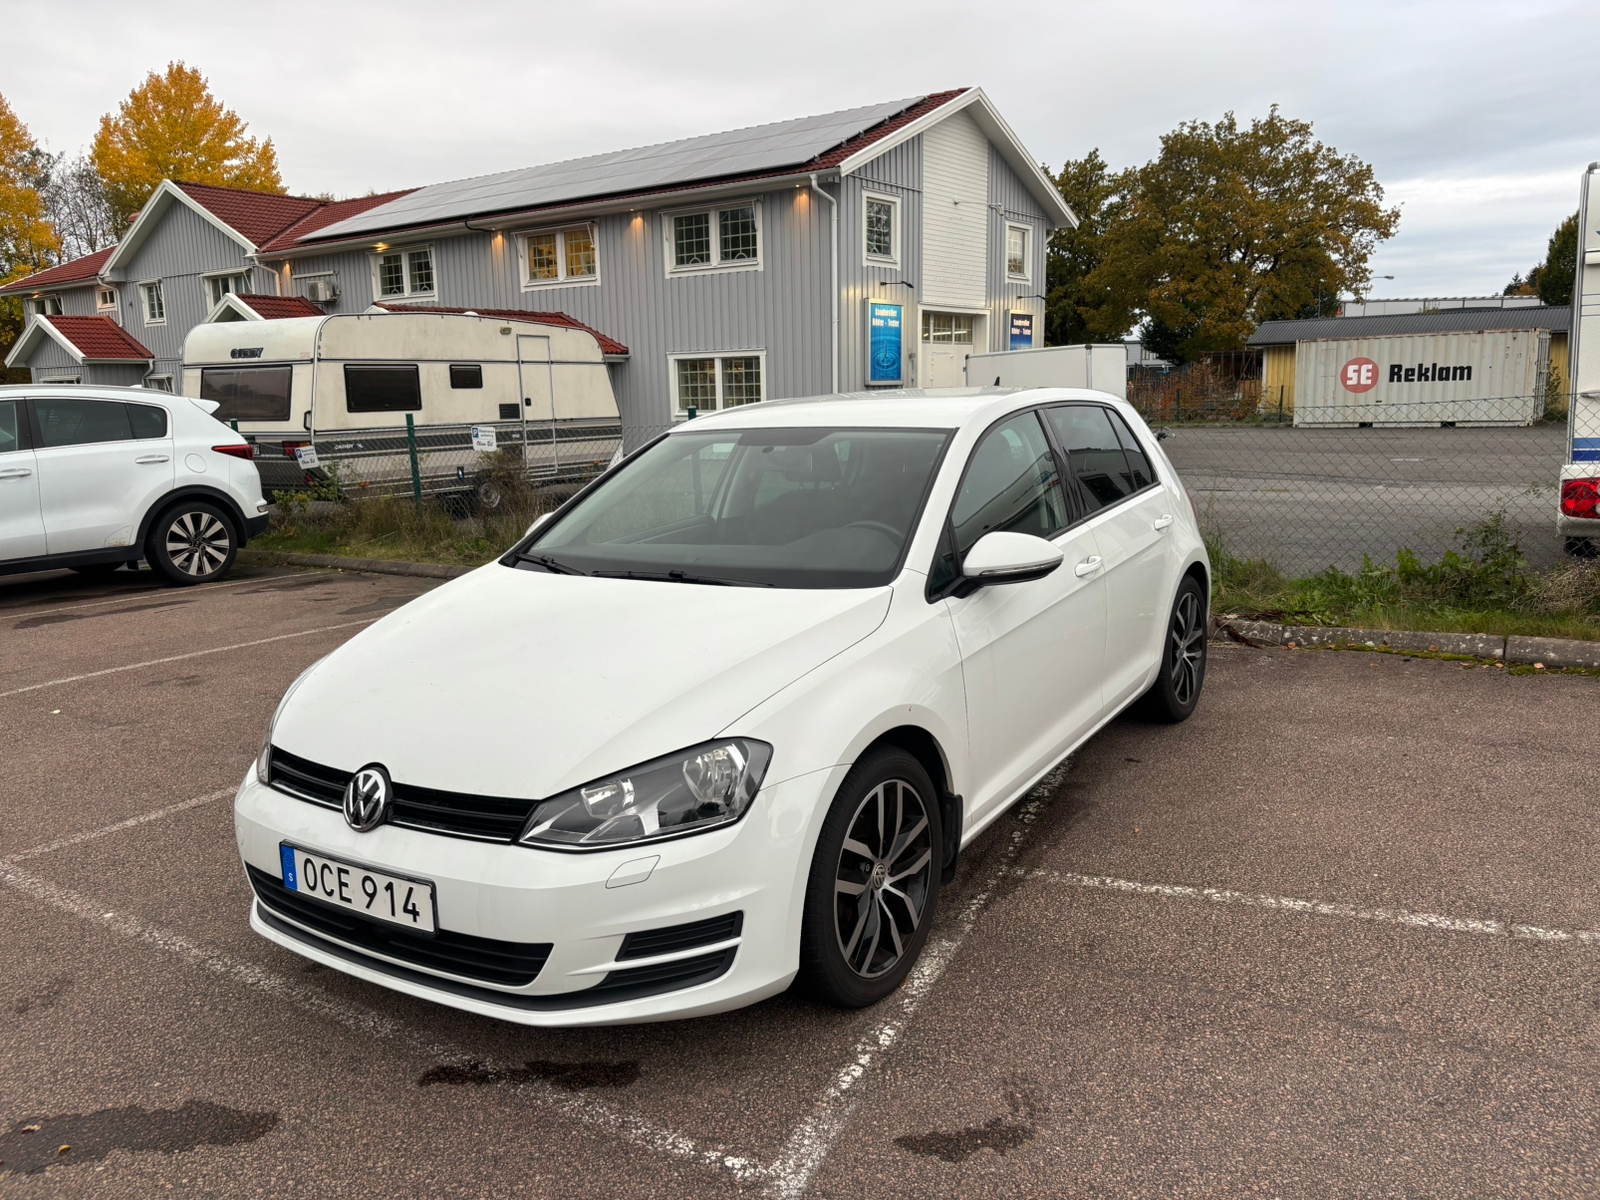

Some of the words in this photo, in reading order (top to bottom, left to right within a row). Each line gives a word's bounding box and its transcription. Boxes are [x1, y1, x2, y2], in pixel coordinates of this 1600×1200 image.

[1346, 364, 1373, 386] SE
[1388, 362, 1473, 383] Reklam
[288, 872, 294, 882] S
[303, 857, 353, 904] OCE
[361, 875, 420, 923] 914
